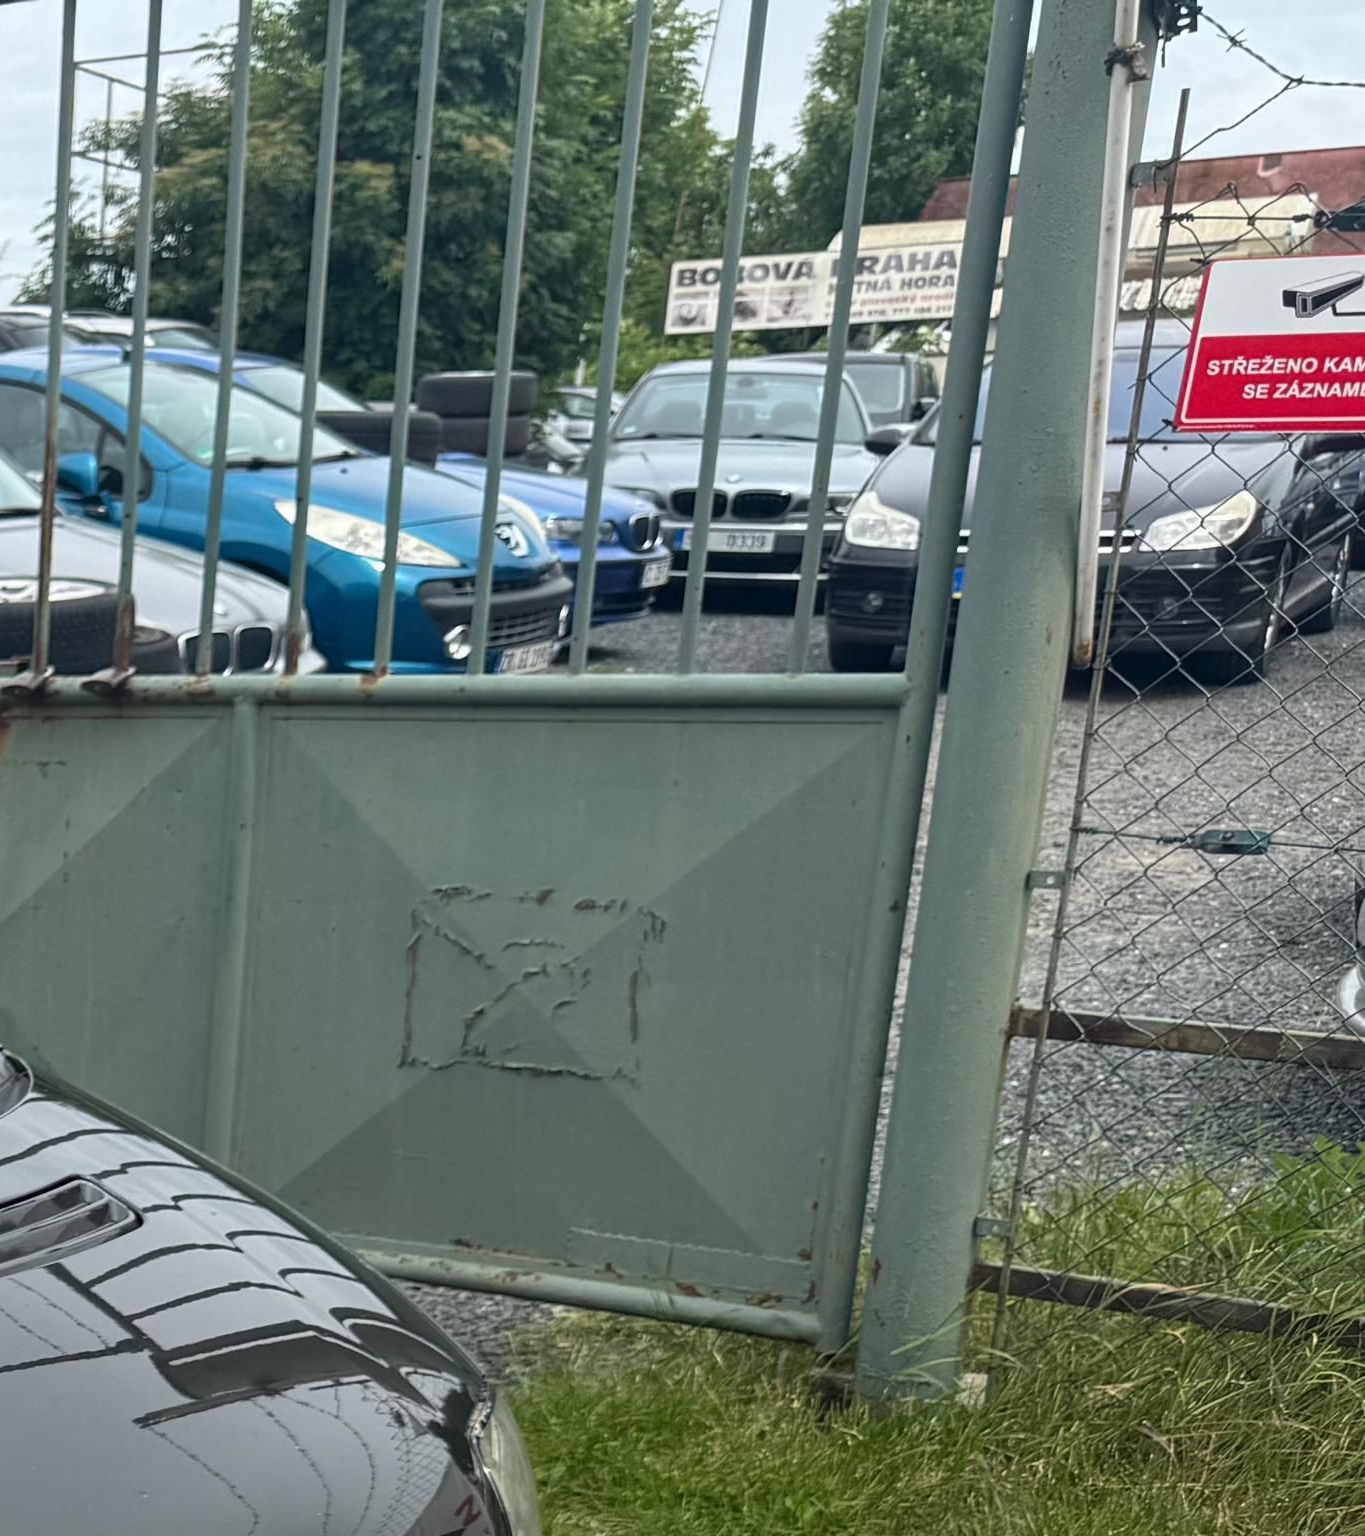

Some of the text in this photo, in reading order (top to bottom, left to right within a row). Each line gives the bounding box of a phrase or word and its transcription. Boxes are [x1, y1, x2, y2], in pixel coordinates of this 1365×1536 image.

[899, 275, 955, 290] HORA
[1206, 355, 1318, 376] STŘEŽENO
[1242, 384, 1270, 400] SE
